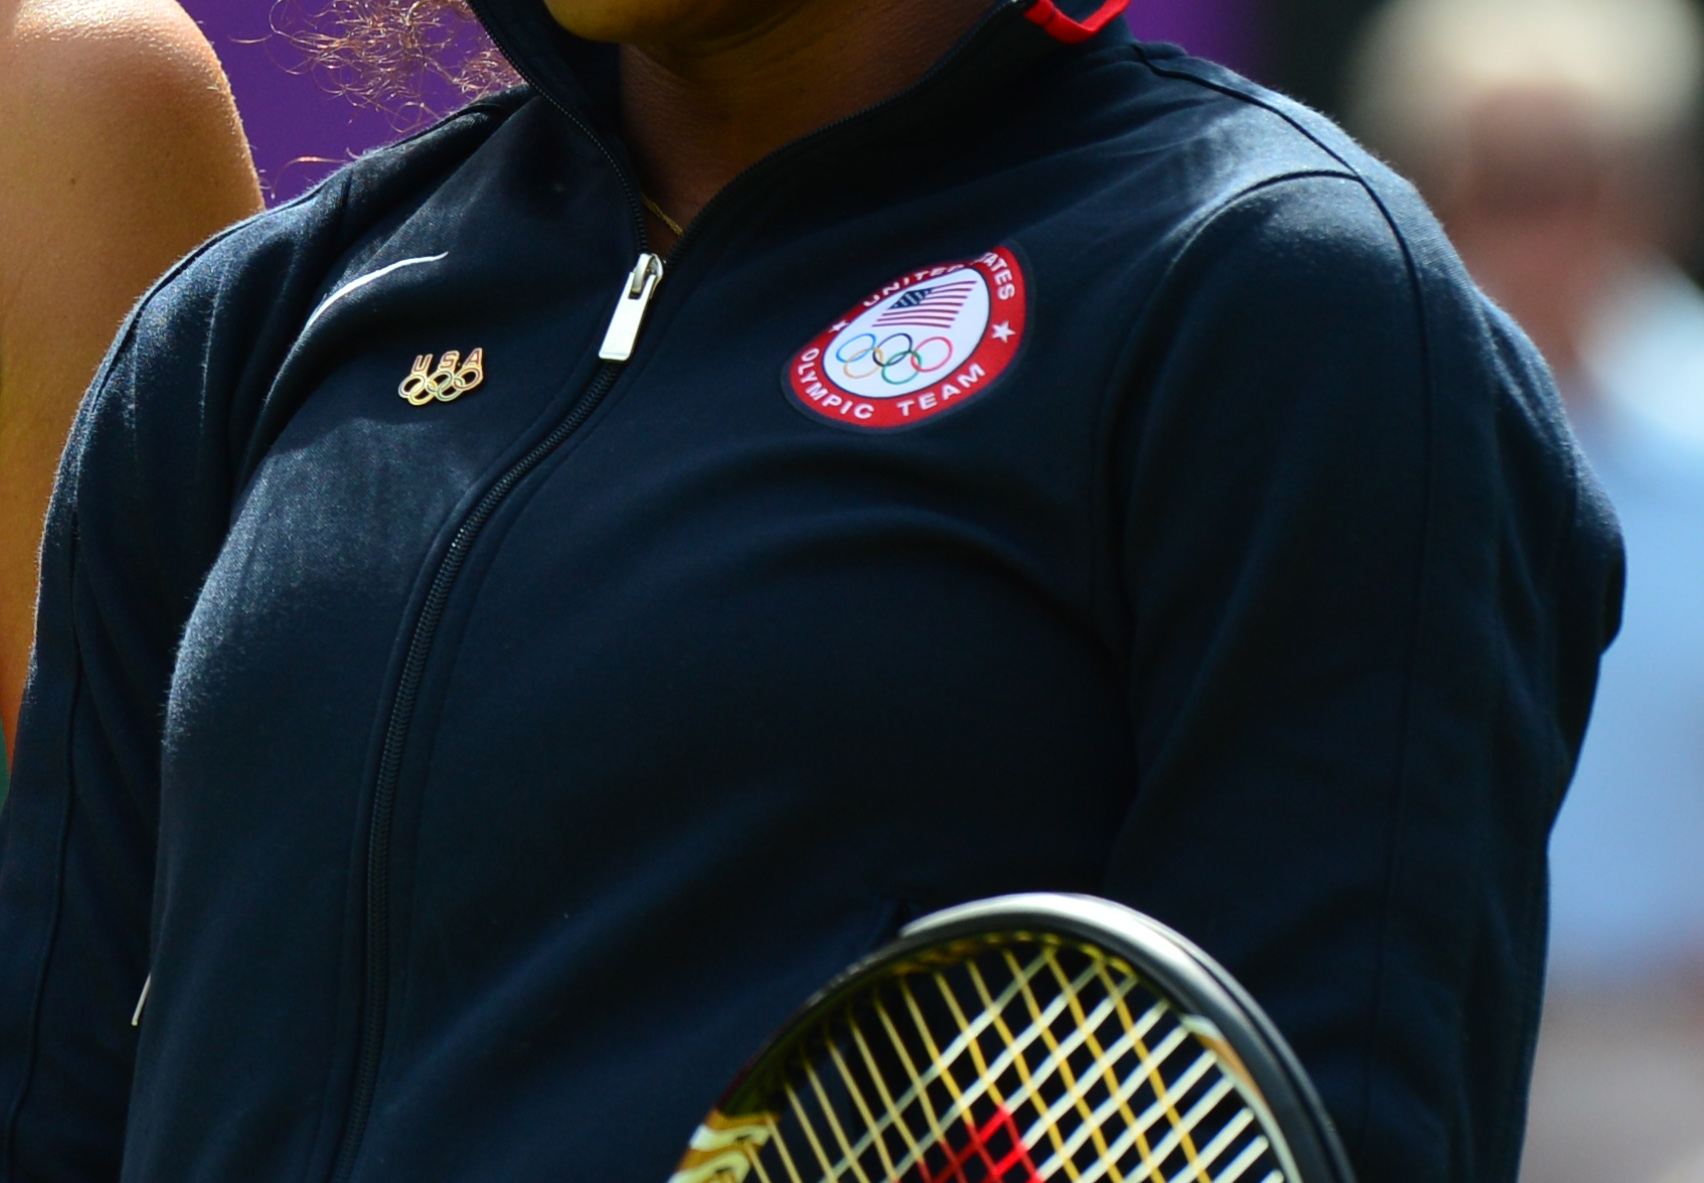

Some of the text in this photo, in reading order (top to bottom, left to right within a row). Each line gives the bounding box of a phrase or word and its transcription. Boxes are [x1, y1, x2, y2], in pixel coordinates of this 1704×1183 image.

[412, 348, 482, 372] USA
[797, 347, 986, 419] OLYMPIC TEAM
